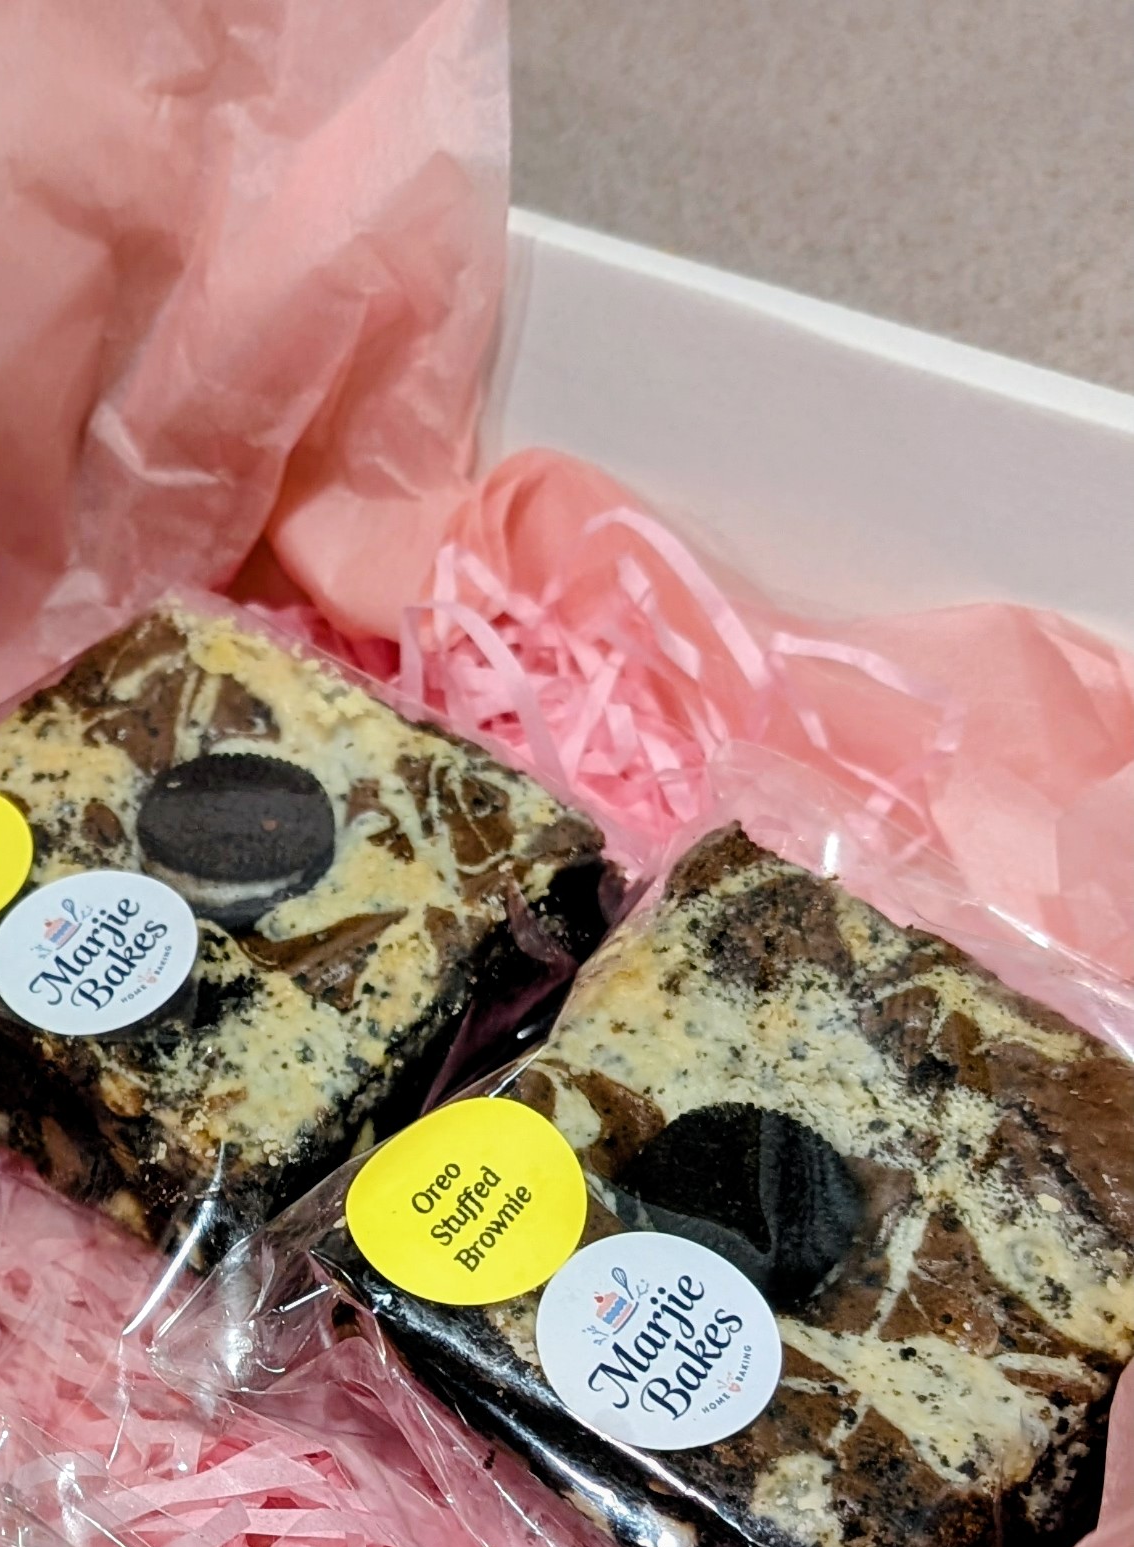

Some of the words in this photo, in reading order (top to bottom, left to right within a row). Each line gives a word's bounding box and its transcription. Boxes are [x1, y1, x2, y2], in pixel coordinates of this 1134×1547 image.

[29, 898, 140, 1006] Marjie
[70, 919, 168, 1011] Bakes
[120, 983, 147, 1004] HOME
[412, 1162, 461, 1215] Oreo
[430, 1166, 502, 1246] Stuffed
[454, 1183, 532, 1272] Brownie
[588, 1274, 705, 1409] Marjie
[640, 1308, 743, 1421] Bakes
[701, 1393, 731, 1413] HOME
[737, 1344, 753, 1383] BAKING
